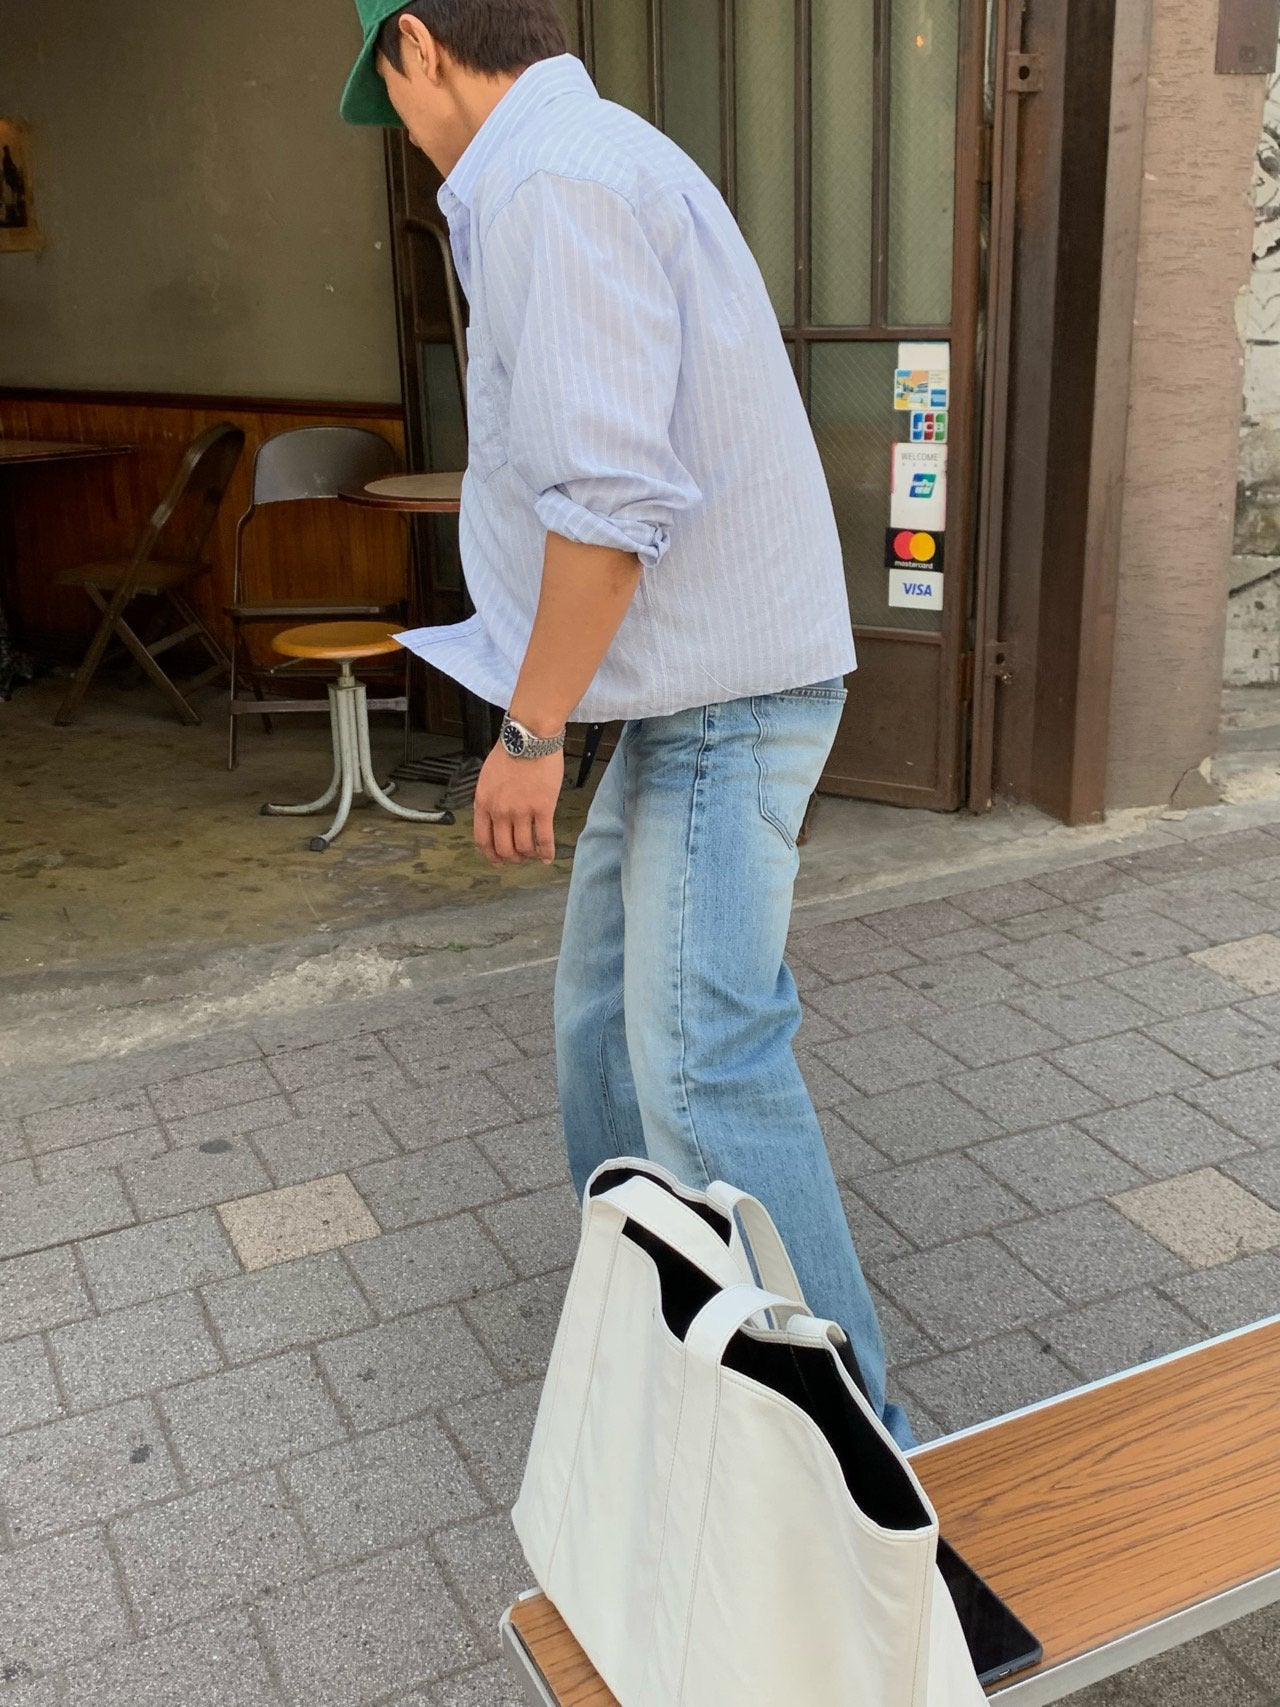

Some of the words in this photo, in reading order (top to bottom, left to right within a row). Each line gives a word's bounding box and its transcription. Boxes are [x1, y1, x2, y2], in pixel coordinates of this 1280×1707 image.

[913, 421, 944, 432] JCB
[901, 453, 939, 461] WELCOME
[894, 561, 933, 569] mastercard
[903, 582, 932, 596] VISA
